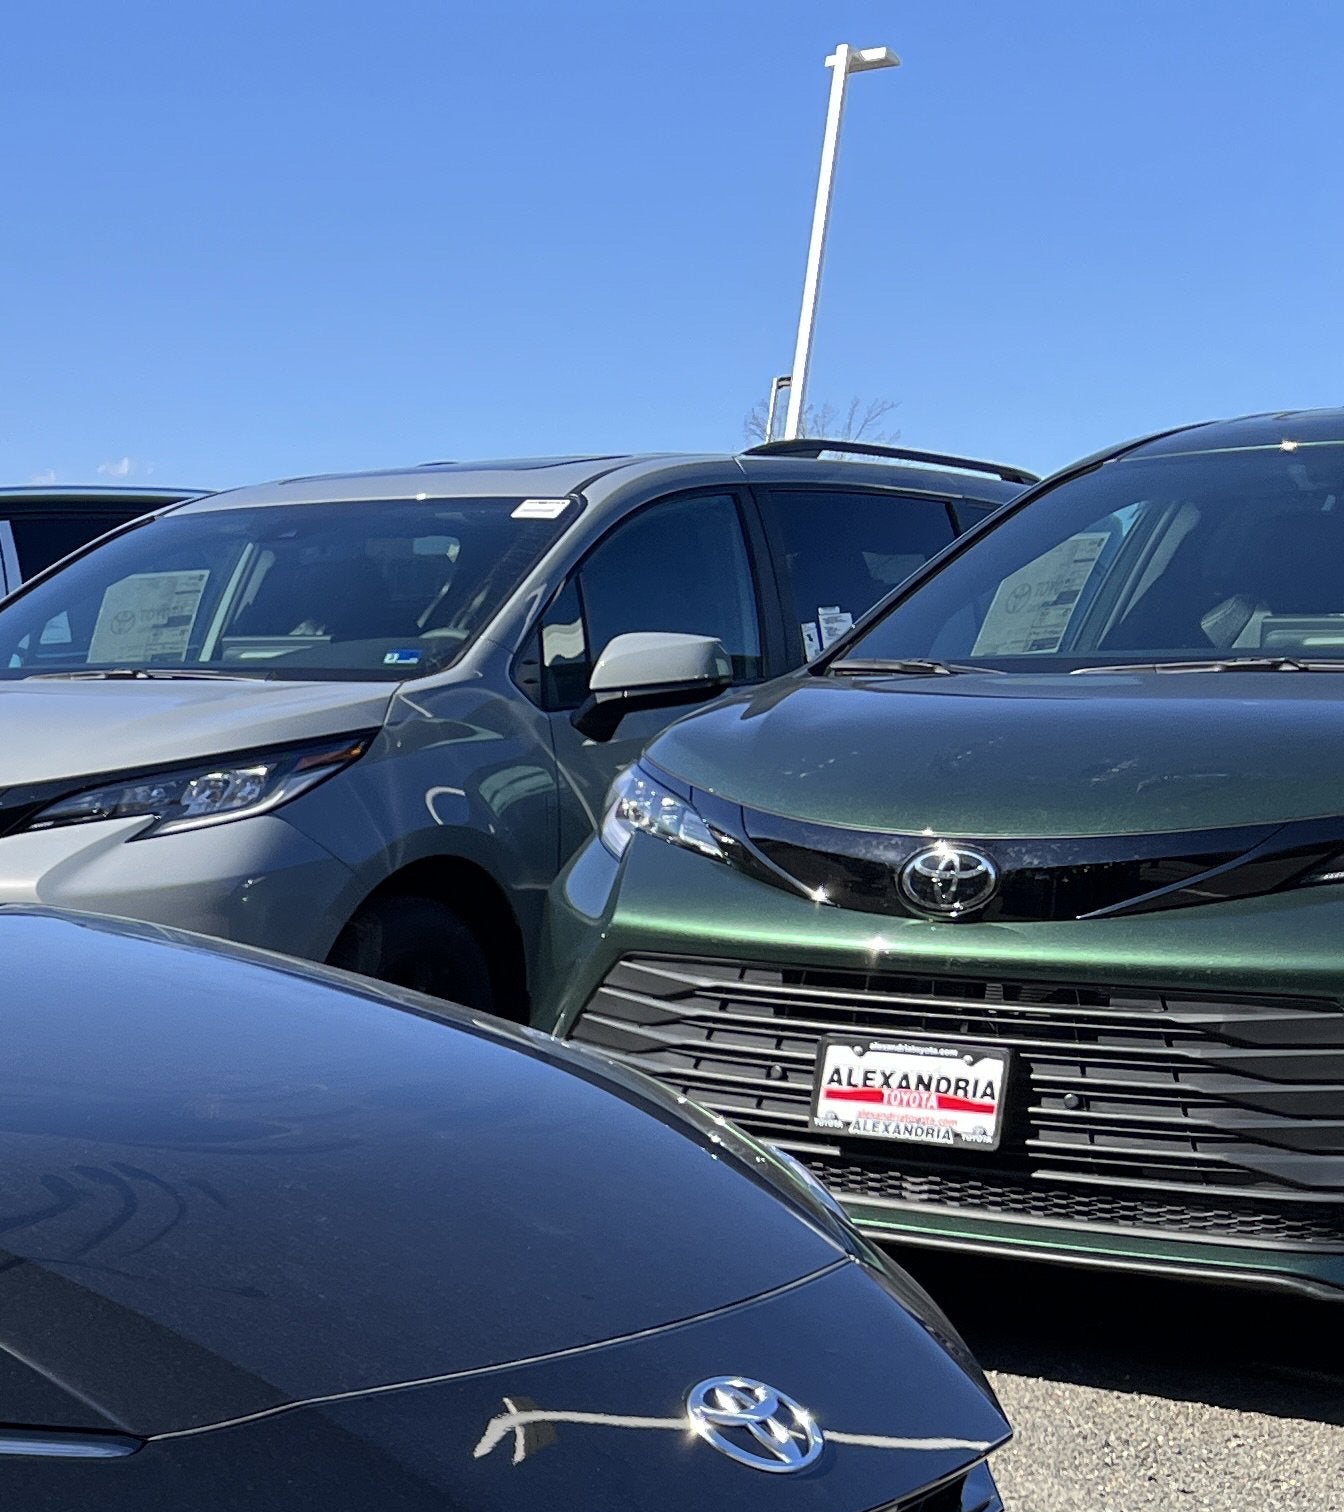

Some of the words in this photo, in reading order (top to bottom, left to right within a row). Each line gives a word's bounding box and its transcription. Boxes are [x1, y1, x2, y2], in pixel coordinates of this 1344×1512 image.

[827, 1067, 996, 1100] ALEXANDRIA
[882, 1090, 936, 1110] TOYOTA
[850, 1119, 952, 1143] ALEXANDRIA
